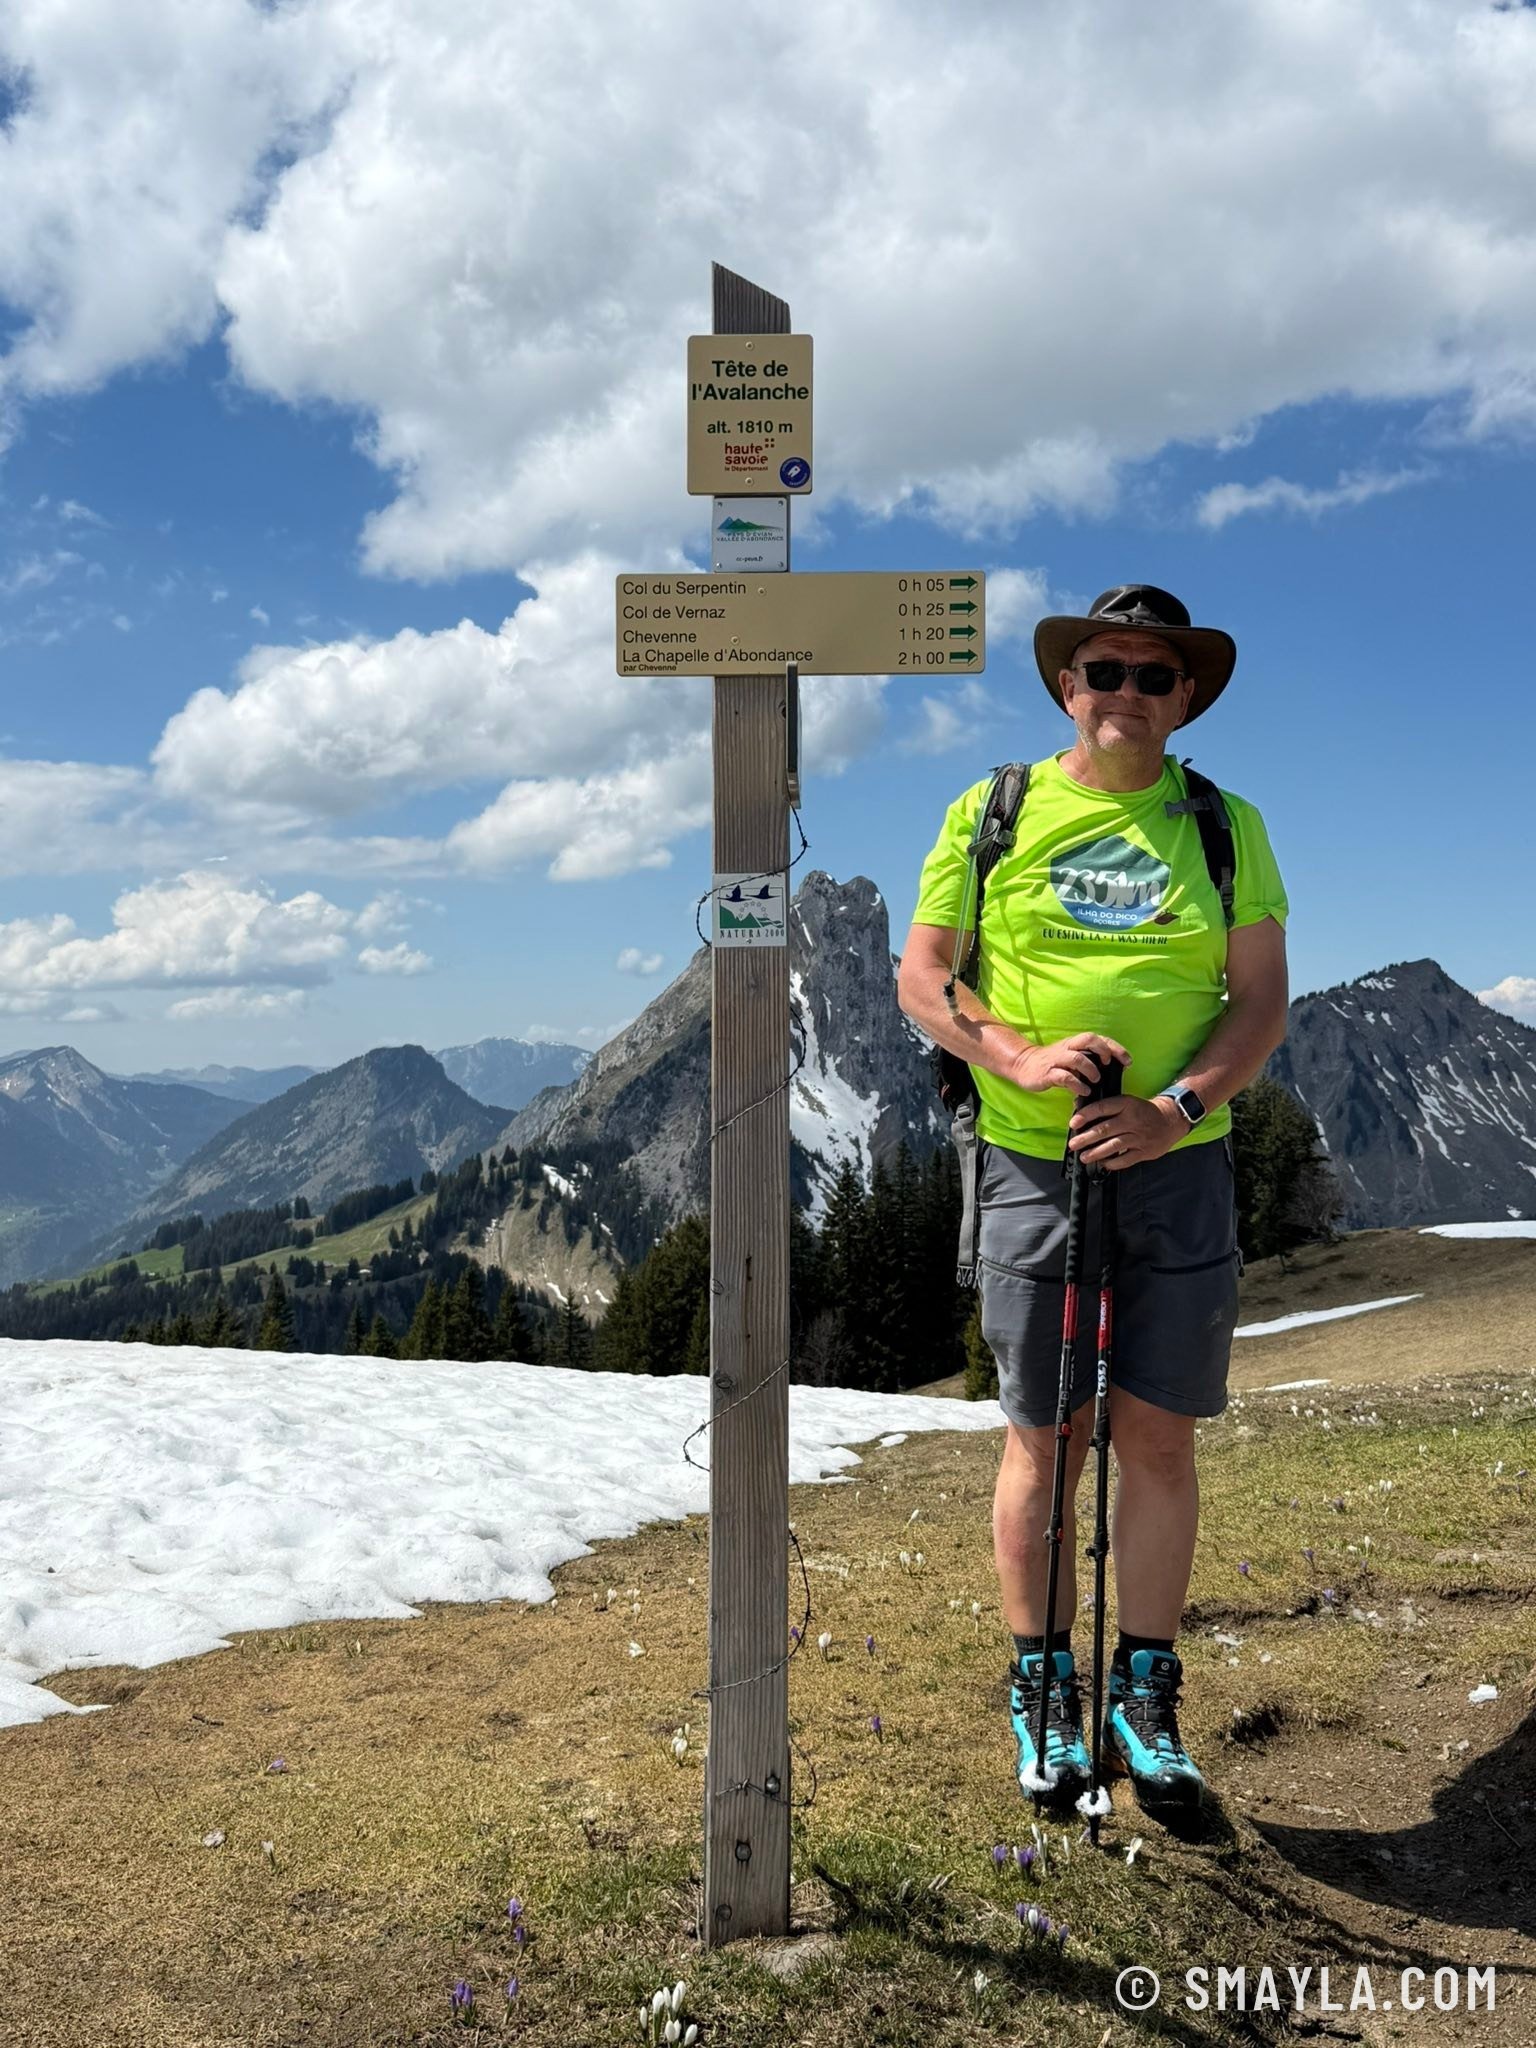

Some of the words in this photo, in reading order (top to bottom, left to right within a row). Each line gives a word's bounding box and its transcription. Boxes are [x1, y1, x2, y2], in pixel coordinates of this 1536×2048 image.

[712, 360, 757, 377] Tête
[763, 360, 789, 377] de
[692, 383, 809, 400] l'Avalanche
[707, 420, 731, 433] alt.
[737, 420, 774, 433] 1810
[779, 423, 793, 433] m
[725, 442, 763, 454] haute
[725, 455, 768, 464] savoie
[623, 581, 647, 595] Col
[652, 581, 671, 595] du
[676, 581, 746, 597] Serpentin
[898, 579, 908, 592] 0
[912, 579, 921, 592] h
[926, 579, 945, 592] 05
[623, 606, 647, 619] Col
[652, 606, 671, 619] de
[675, 606, 725, 619] Vernaz
[898, 603, 908, 616] 0
[912, 603, 921, 616] h
[926, 603, 945, 616] 25
[623, 630, 697, 643] Chevenne
[900, 627, 905, 640] 1
[912, 627, 921, 640] h
[926, 627, 945, 640] 20
[623, 650, 640, 662] La
[645, 649, 709, 665] Chapelle
[714, 649, 813, 662] d'Abondance
[898, 652, 908, 665] 2
[912, 652, 921, 665] h
[926, 652, 945, 665] 00
[1077, 908, 1098, 917] ILHA
[1100, 911, 1114, 919] DO
[1115, 912, 1138, 921] PICO
[720, 929, 761, 938] NATURA
[765, 929, 785, 938] 2000
[1043, 928, 1055, 939] EU
